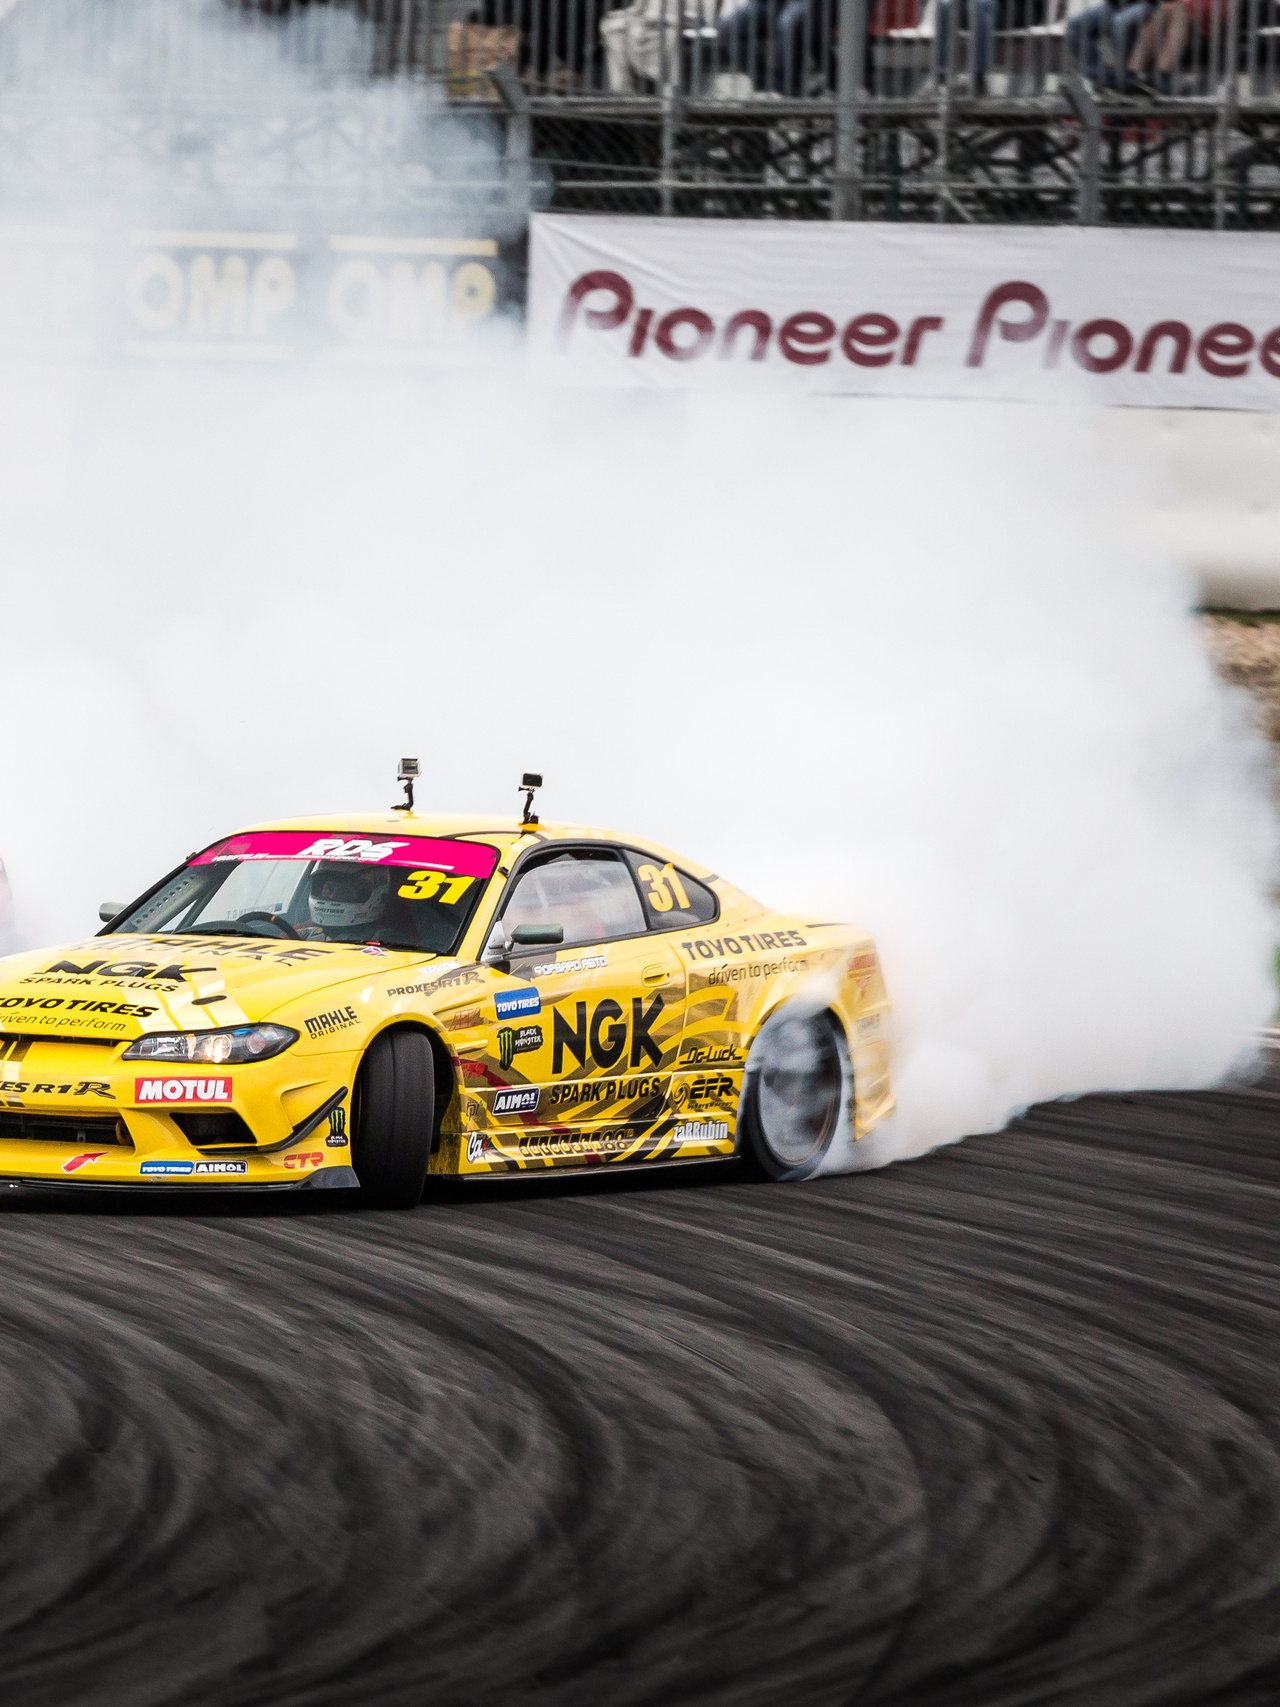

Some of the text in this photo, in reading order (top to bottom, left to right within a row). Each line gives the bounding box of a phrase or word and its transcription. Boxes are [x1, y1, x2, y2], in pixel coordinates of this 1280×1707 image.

[127, 253, 298, 337] OMP
[329, 260, 496, 342] OMP
[557, 269, 944, 367] Pioneer
[296, 838, 410, 859] RDS
[397, 870, 475, 905] 31
[637, 863, 691, 913] 31
[682, 930, 809, 962] TOYO TIRES
[33, 960, 217, 983] NGK
[708, 959, 809, 986] driven to perform
[20, 976, 179, 993] SPARK PLUGS
[387, 981, 440, 998] PROXES
[71, 1001, 160, 1019] TIRES
[497, 997, 539, 1012] TOYO TIRES
[39, 1016, 56, 1028] to
[56, 1018, 127, 1033] perform
[304, 1006, 358, 1034] MAHLE
[310, 1017, 361, 1040] ORIGINAL
[519, 1028, 537, 1038] BLACK
[552, 993, 664, 1075] NGK
[138, 1081, 229, 1101] MOTUL
[550, 1077, 661, 1104] SPARK PLUGS
[690, 1077, 733, 1099] EFR
[495, 1092, 537, 1111] AIMOL
[196, 1163, 245, 1173] AIMOL
[283, 1152, 324, 1169] CTR
